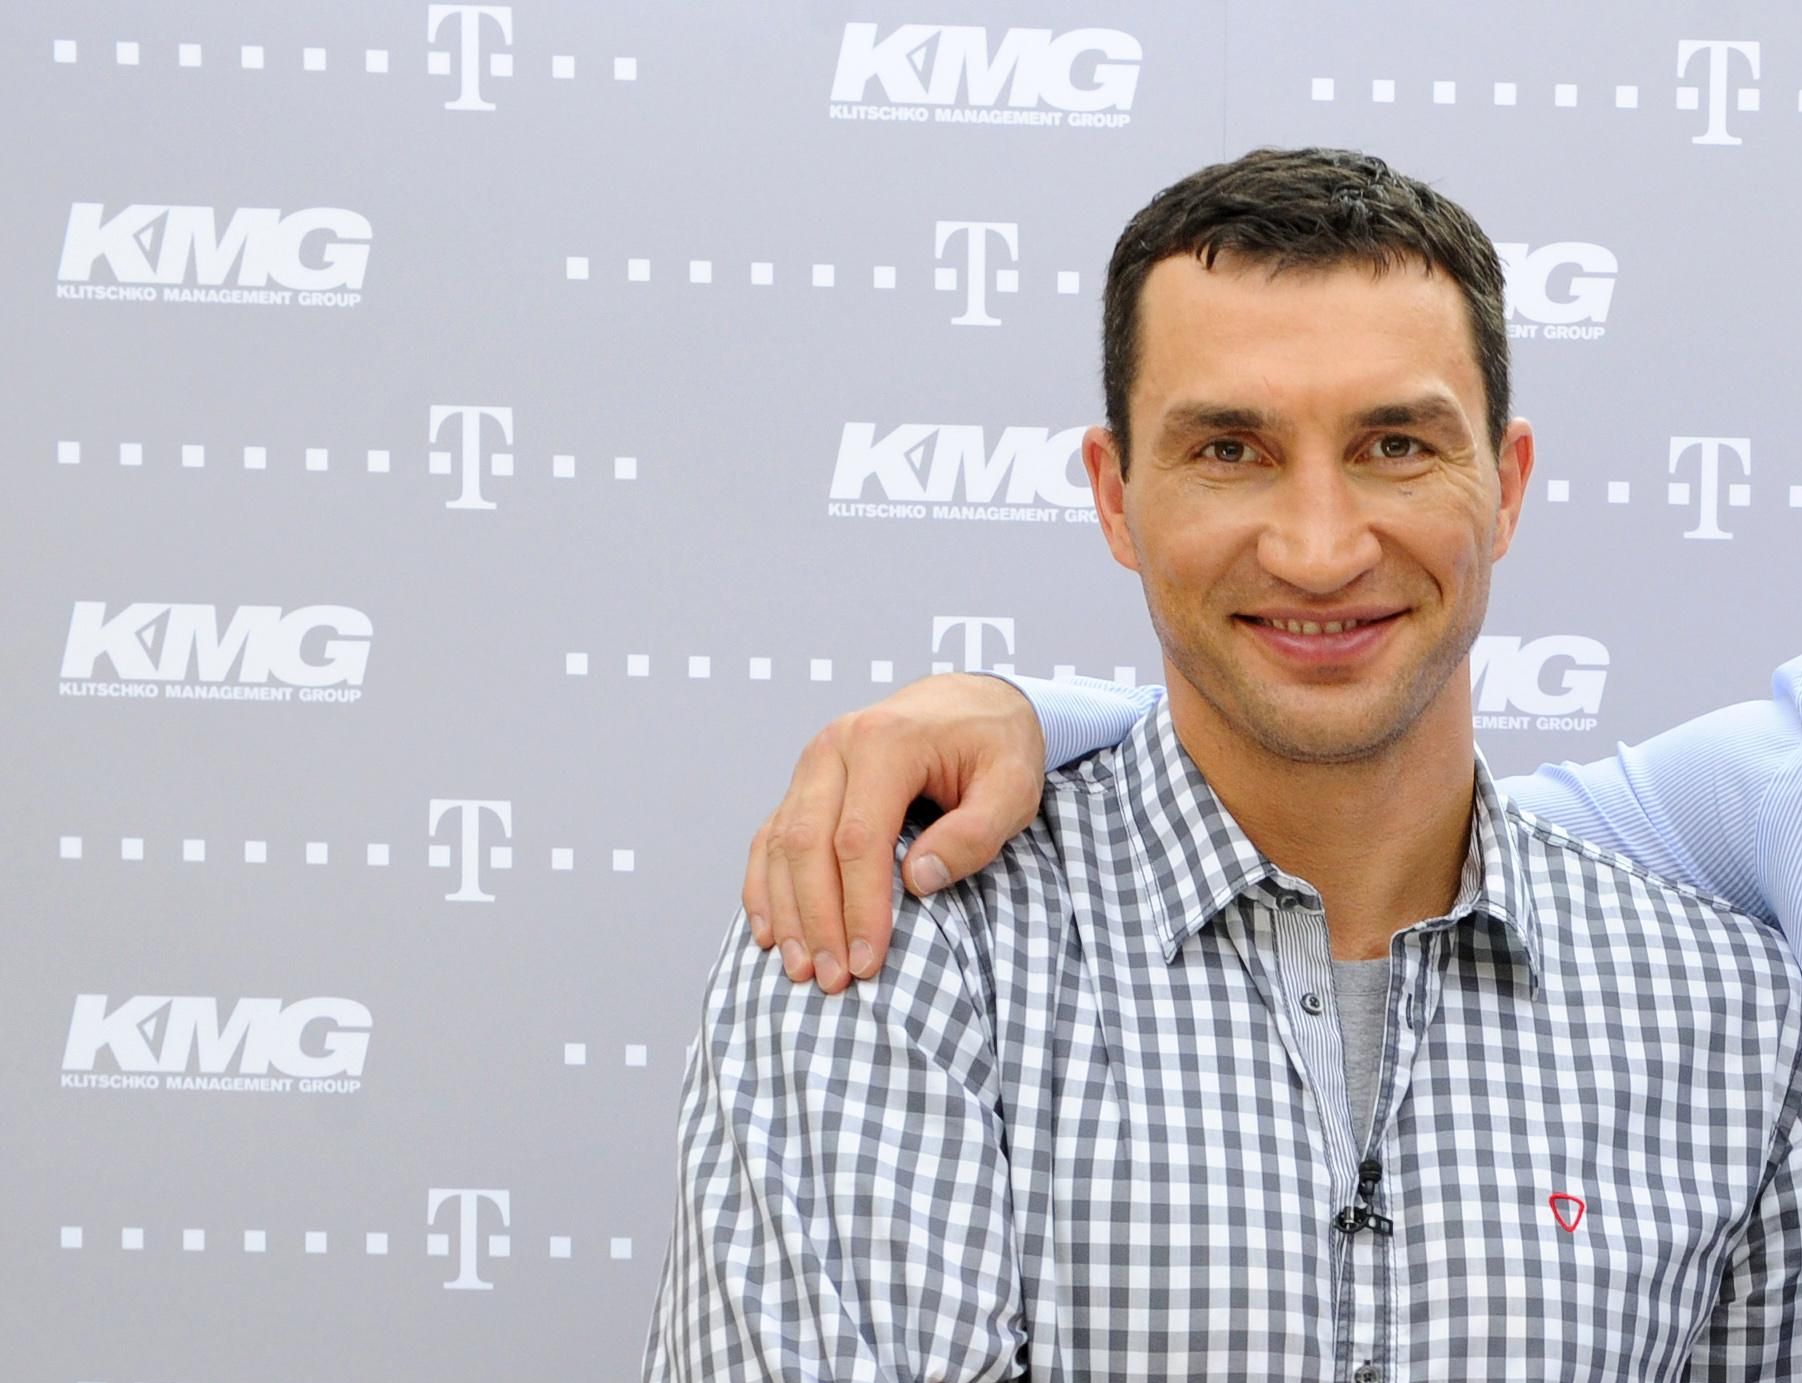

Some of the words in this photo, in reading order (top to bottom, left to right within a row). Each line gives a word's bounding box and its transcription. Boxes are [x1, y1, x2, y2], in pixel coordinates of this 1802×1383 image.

[429, 5, 511, 110] T
[830, 23, 1142, 108] KMG
[1678, 41, 1759, 144] T
[829, 104, 929, 122] KLITSCHKO
[935, 107, 1063, 126] MANAGEMENT
[1067, 111, 1131, 128] GROUP
[58, 203, 372, 288] KMG
[936, 222, 1017, 325] T
[56, 284, 157, 301] KLITSCHKO
[163, 287, 293, 305] MANAGEMENT
[297, 291, 361, 307] GROUP
[1543, 325, 1605, 340] GROUP
[430, 406, 512, 509] T
[1670, 437, 1750, 539] T
[828, 503, 927, 519] KLITSCHKO
[932, 505, 1059, 523] MANAGEMENT
[1064, 508, 1099, 524] GRO
[61, 602, 373, 686] KMG
[59, 682, 159, 698] KLITSCHKO
[165, 684, 293, 701] MANAGEMENT
[298, 687, 362, 703] GROUP
[1535, 717, 1597, 730] GROUP
[430, 800, 511, 901] T
[62, 995, 372, 1077] KMG
[61, 1074, 160, 1089] KLITSCHKO
[166, 1076, 293, 1092] MANAGEMENT
[298, 1078, 361, 1093] GROUP
[428, 1189, 509, 1289] T
